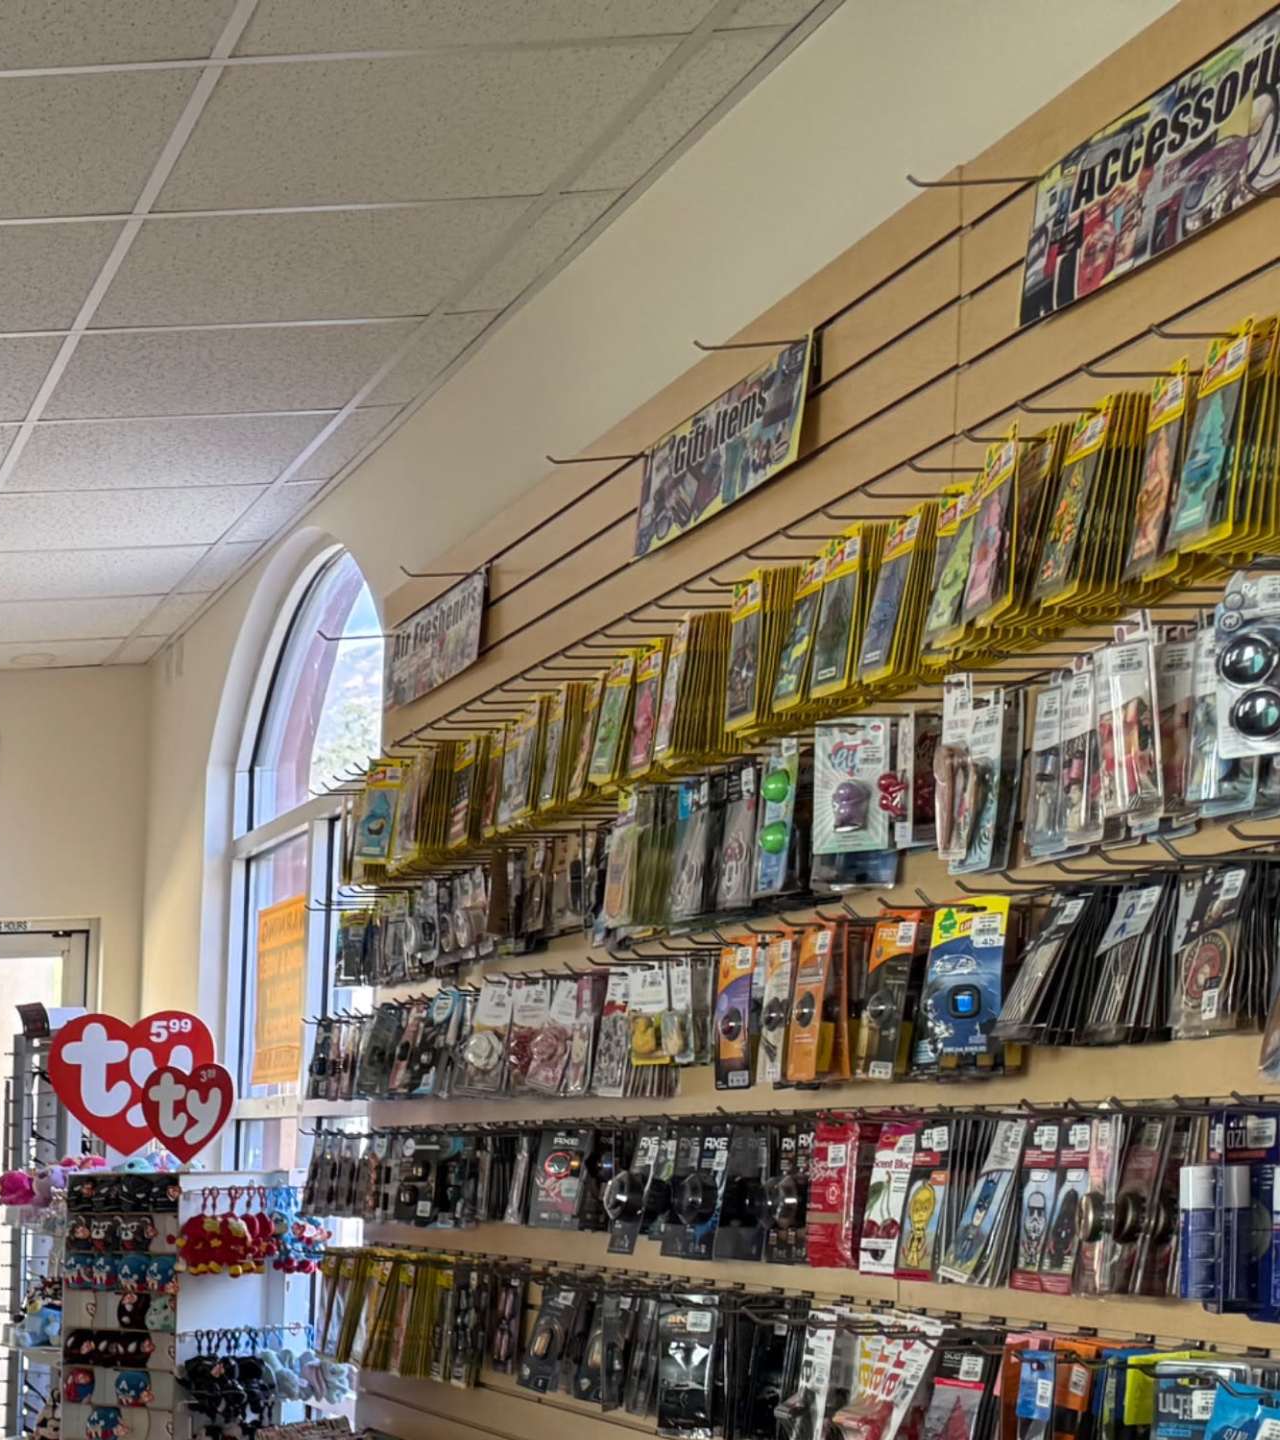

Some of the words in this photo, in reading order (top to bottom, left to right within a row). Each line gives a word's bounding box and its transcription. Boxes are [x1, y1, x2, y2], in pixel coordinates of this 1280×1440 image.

[673, 421, 707, 475] Gift
[713, 390, 768, 450] Items
[4, 920, 28, 930] HOURS
[61, 1022, 194, 1128] ty
[148, 1072, 222, 1146] ty
[553, 1137, 580, 1146] AXE
[704, 1137, 729, 1150] AXE
